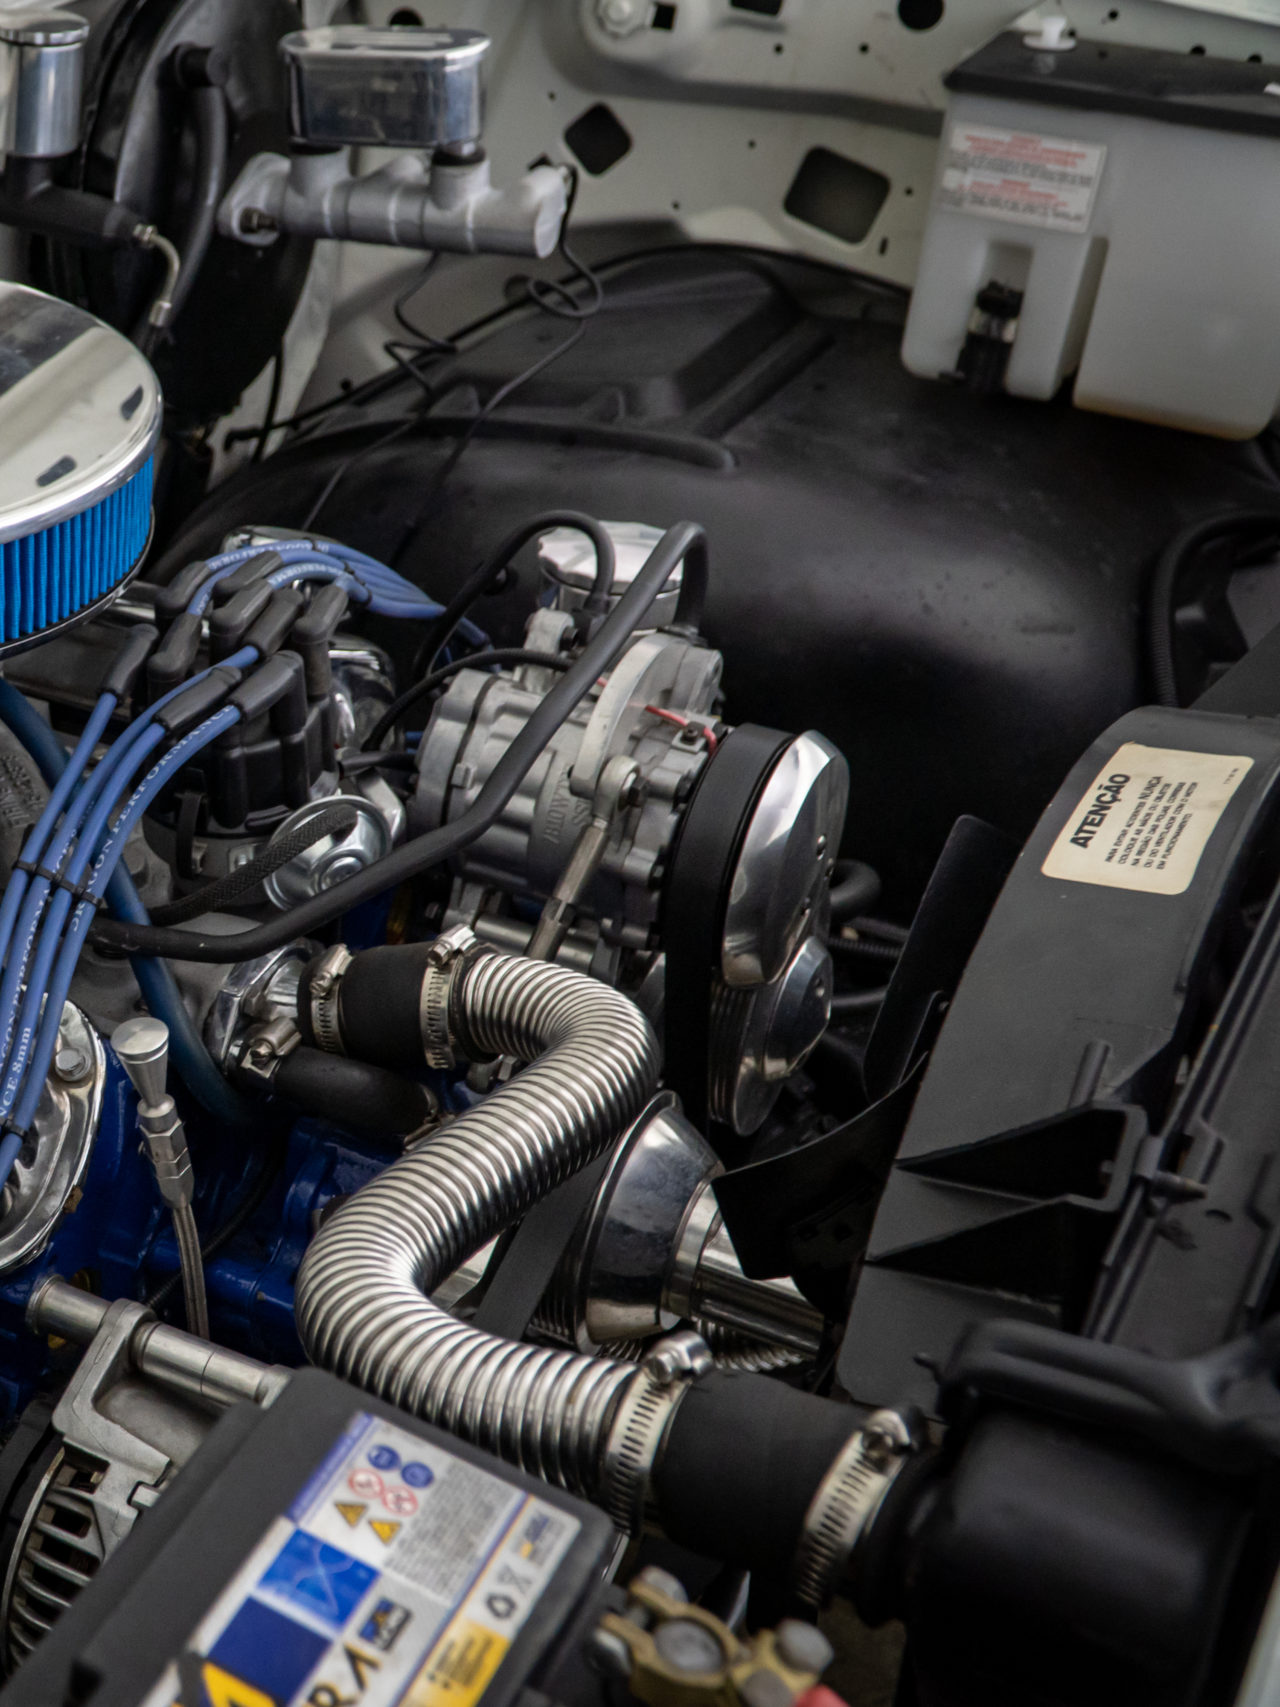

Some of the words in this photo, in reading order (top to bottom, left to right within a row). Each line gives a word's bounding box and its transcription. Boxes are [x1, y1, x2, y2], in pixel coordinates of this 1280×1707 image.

[1138, 776, 1163, 800] NUNCA
[1070, 773, 1131, 848] ATENÇÃO
[1118, 837, 1138, 864] COLOQUE
[1154, 816, 1176, 847] VENTILADOR
[72, 838, 114, 932] DRGON
[11, 1026, 31, 1074] 8mm
